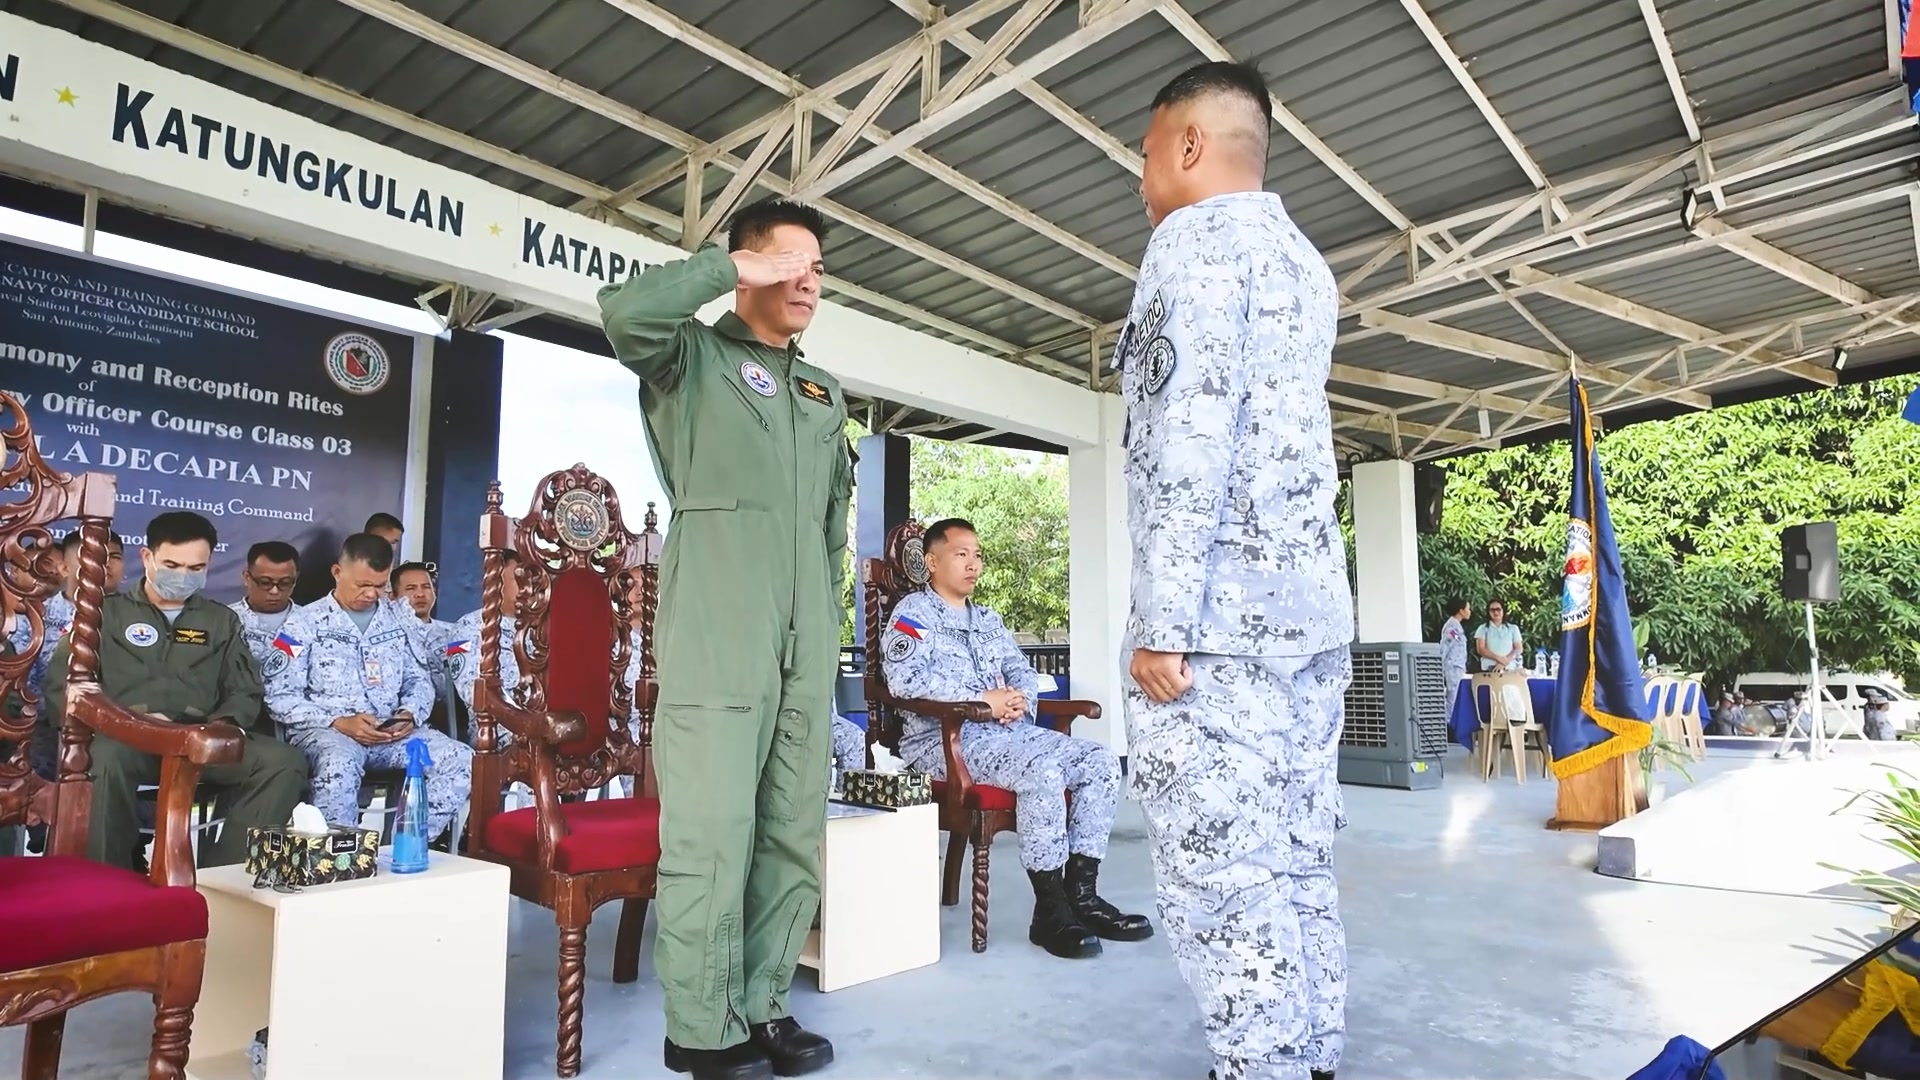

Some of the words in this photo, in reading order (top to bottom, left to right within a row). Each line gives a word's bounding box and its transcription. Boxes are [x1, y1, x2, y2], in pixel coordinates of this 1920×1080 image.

[112, 82, 464, 237] KATUNGKULAN
[523, 217, 650, 283] KATAPA
[1, 275, 47, 294] NAVY
[50, 286, 114, 308] OFFICER
[117, 301, 201, 327] CANDIDATE
[203, 319, 259, 339] SCHOOL
[6, 262, 71, 284] CATION
[75, 278, 108, 293] AND
[111, 285, 181, 309] TRAINING
[184, 302, 256, 326] COMMAND
[27, 296, 70, 312] Station
[74, 304, 135, 326] Leovigildo
[138, 318, 194, 339] Gantioqui
[22, 308, 45, 322] San
[106, 326, 161, 344] Zambales
[78, 380, 97, 392] of
[91, 359, 144, 381] and
[154, 366, 279, 405] Reception
[288, 391, 344, 416] Rites
[43, 392, 142, 424] Officer
[151, 409, 243, 440] Course
[252, 425, 314, 450] Class
[322, 436, 352, 456] 03
[66, 422, 100, 437] with
[62, 440, 91, 464] A
[100, 443, 263, 486] DECAPIA
[271, 466, 313, 492] PN
[149, 489, 225, 517] Training
[228, 498, 313, 522] Command
